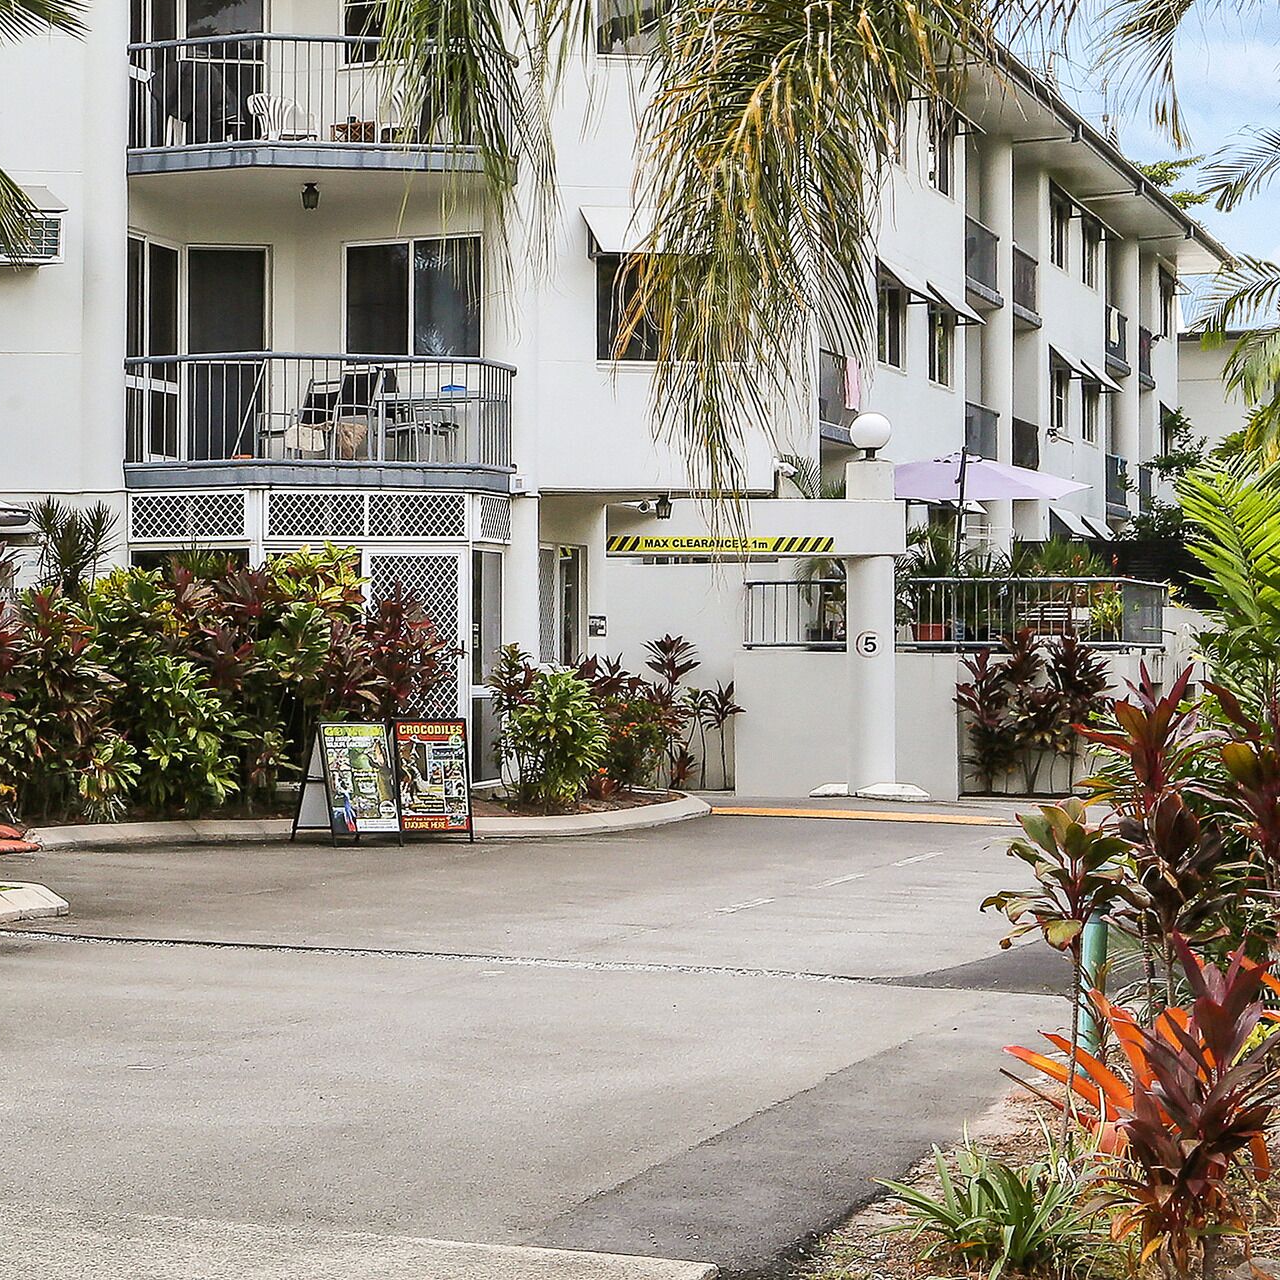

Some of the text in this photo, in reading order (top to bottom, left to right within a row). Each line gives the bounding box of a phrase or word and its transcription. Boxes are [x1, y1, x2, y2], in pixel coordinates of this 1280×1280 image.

[644, 539, 669, 548] MAX
[672, 539, 739, 548] CLEARANCE
[864, 636, 877, 652] 5
[399, 725, 463, 735] CROCODILES
